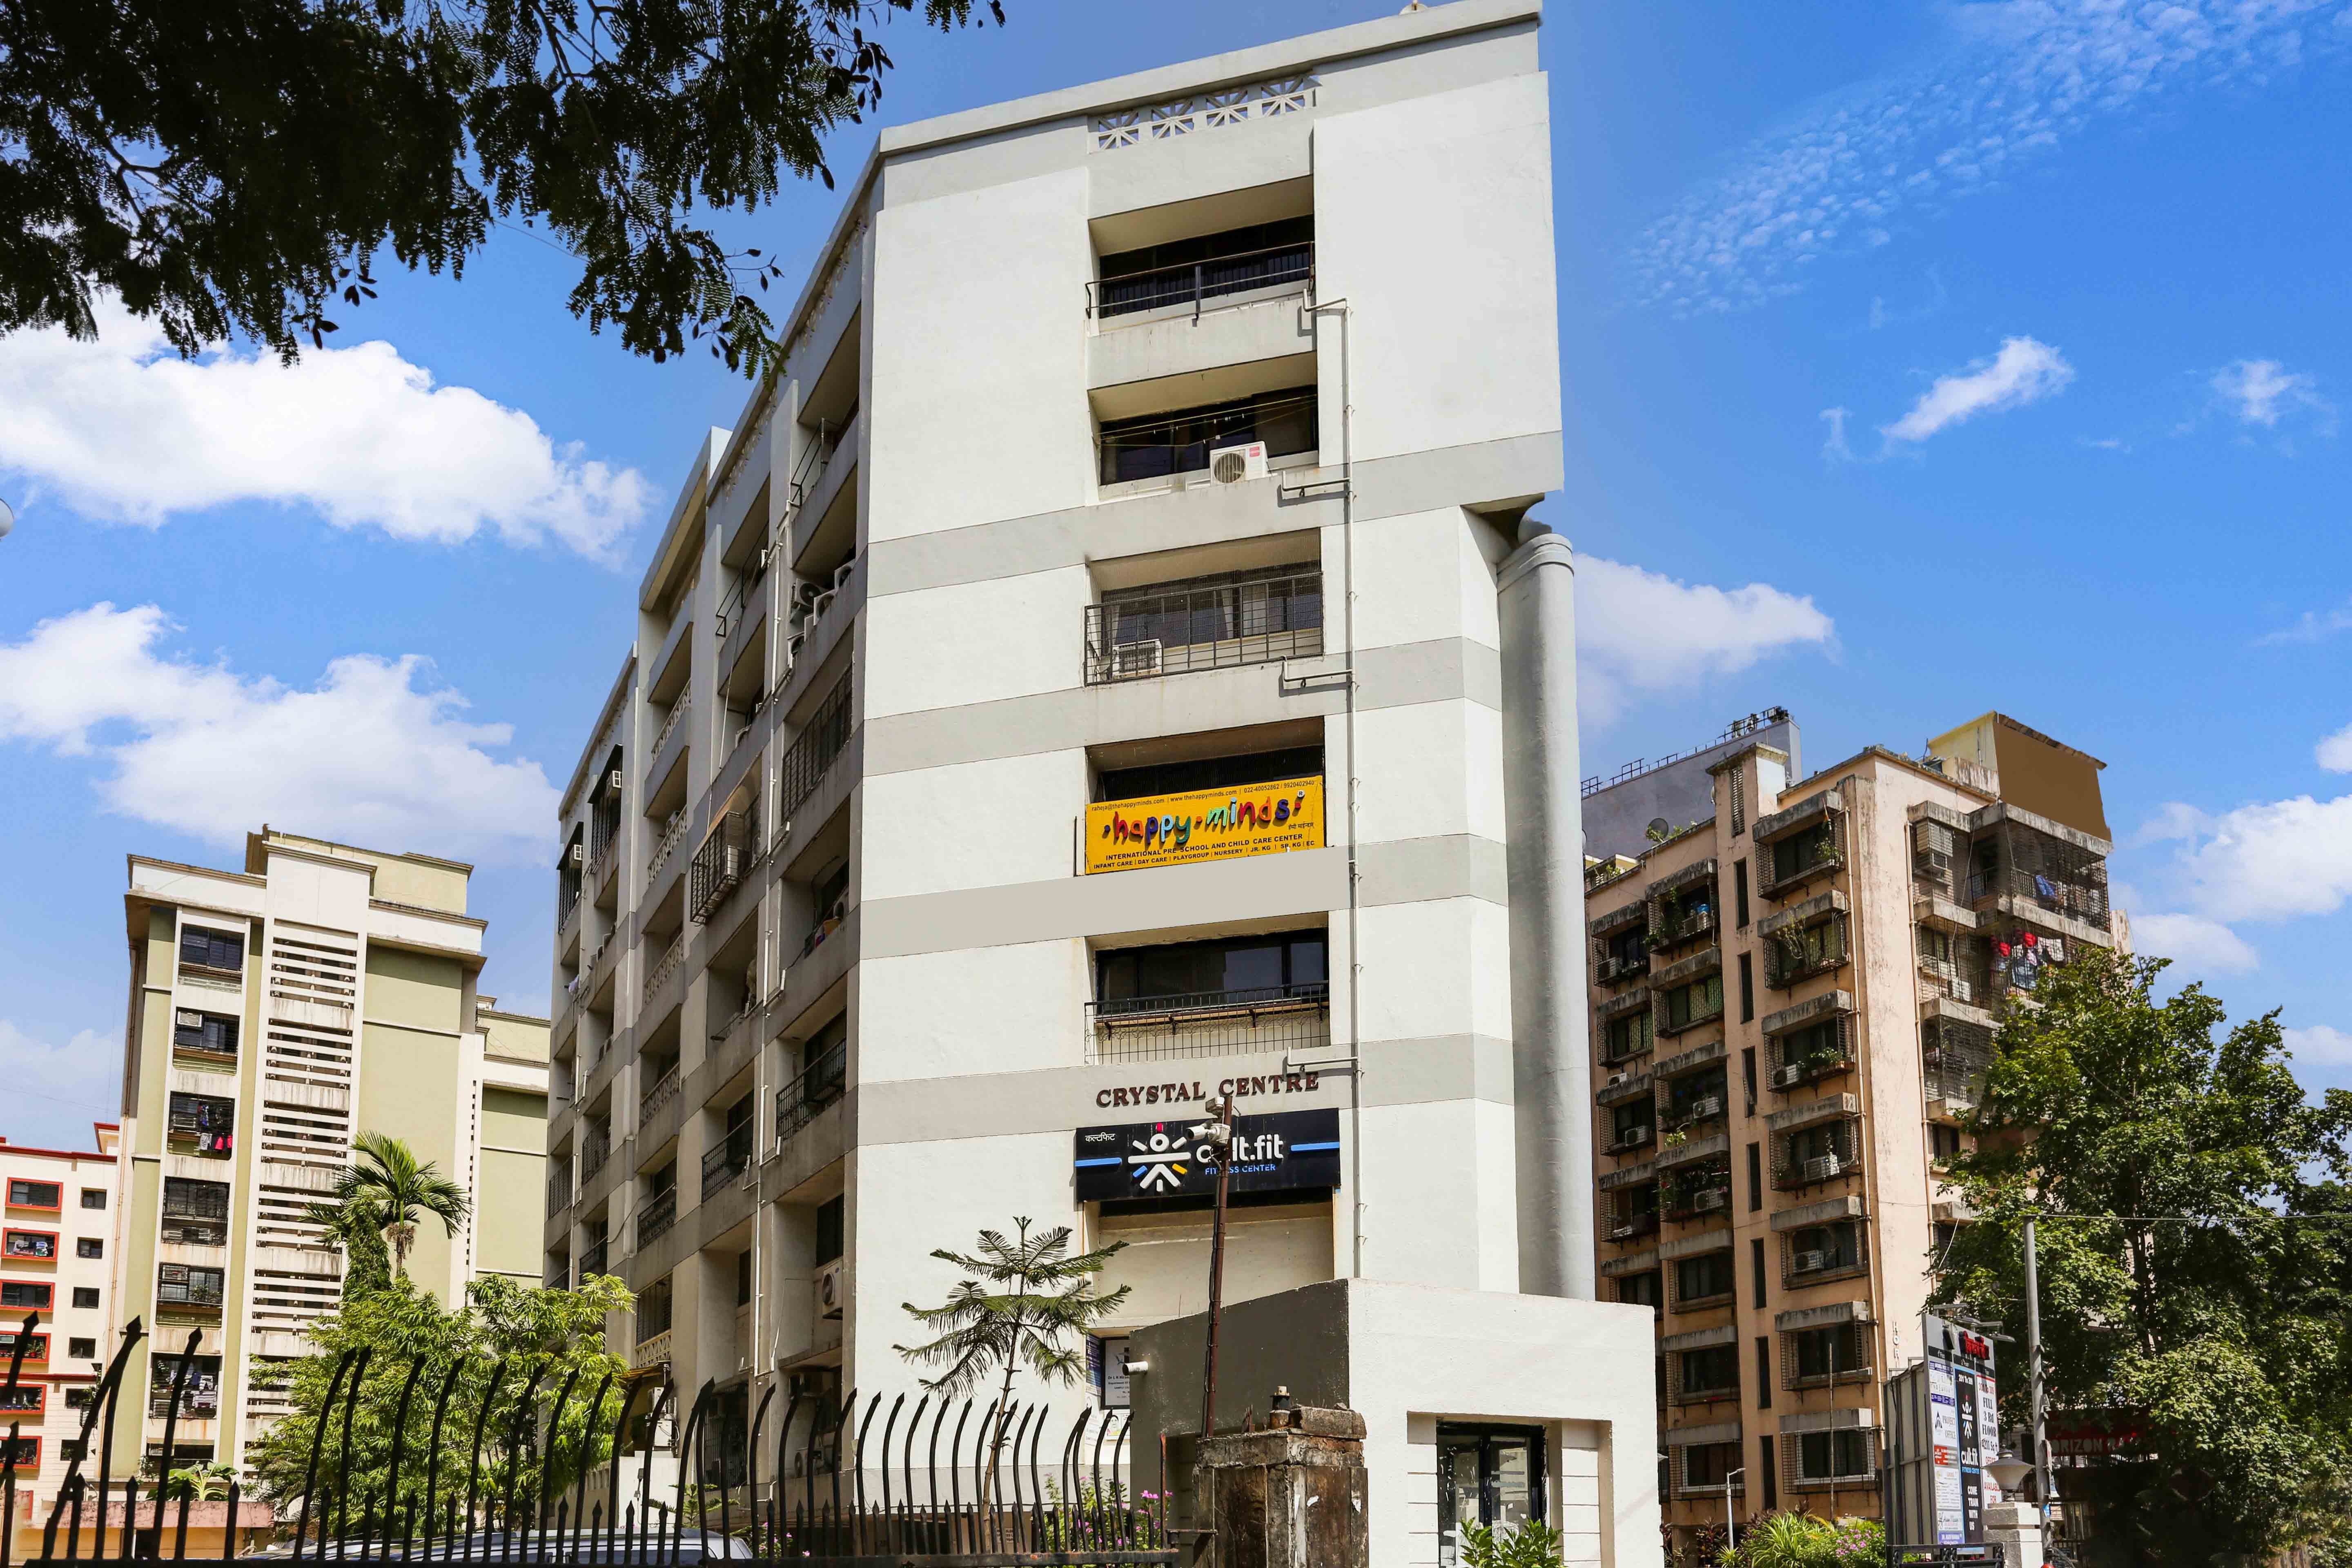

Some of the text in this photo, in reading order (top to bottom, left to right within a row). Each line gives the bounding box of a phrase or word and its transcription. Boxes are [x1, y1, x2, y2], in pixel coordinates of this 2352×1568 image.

[1114, 811, 1191, 844] happy
[1207, 796, 1290, 827] minds
[1106, 851, 1161, 860] INTERNATIONAL
[1179, 844, 1209, 853] SCHOOL
[1228, 839, 1250, 847] CHILD
[1274, 833, 1303, 842] CENTER
[1173, 852, 1209, 861] PLAYGROUP
[1096, 1071, 1319, 1108] CRYSTAL CENTRE
[1085, 1132, 1116, 1143] कल्टफिट
[1196, 1134, 1284, 1163] clt.fit
[1205, 1163, 1276, 1175] FITSS CENTER
[1983, 1397, 1993, 1410] FULL
[1942, 1416, 1955, 1425] PROJECT
[1984, 1411, 1987, 1421] 3
[1944, 1430, 1956, 1439] OFFICE
[1982, 1424, 1996, 1437] FLOOR
[2051, 1438, 2102, 1453] ORIZON
[1967, 1485, 1978, 1495] COME
[1968, 1498, 1979, 1507] TRAIN
[1969, 1509, 1978, 1519] WITH
[1969, 1521, 1975, 1530] US
